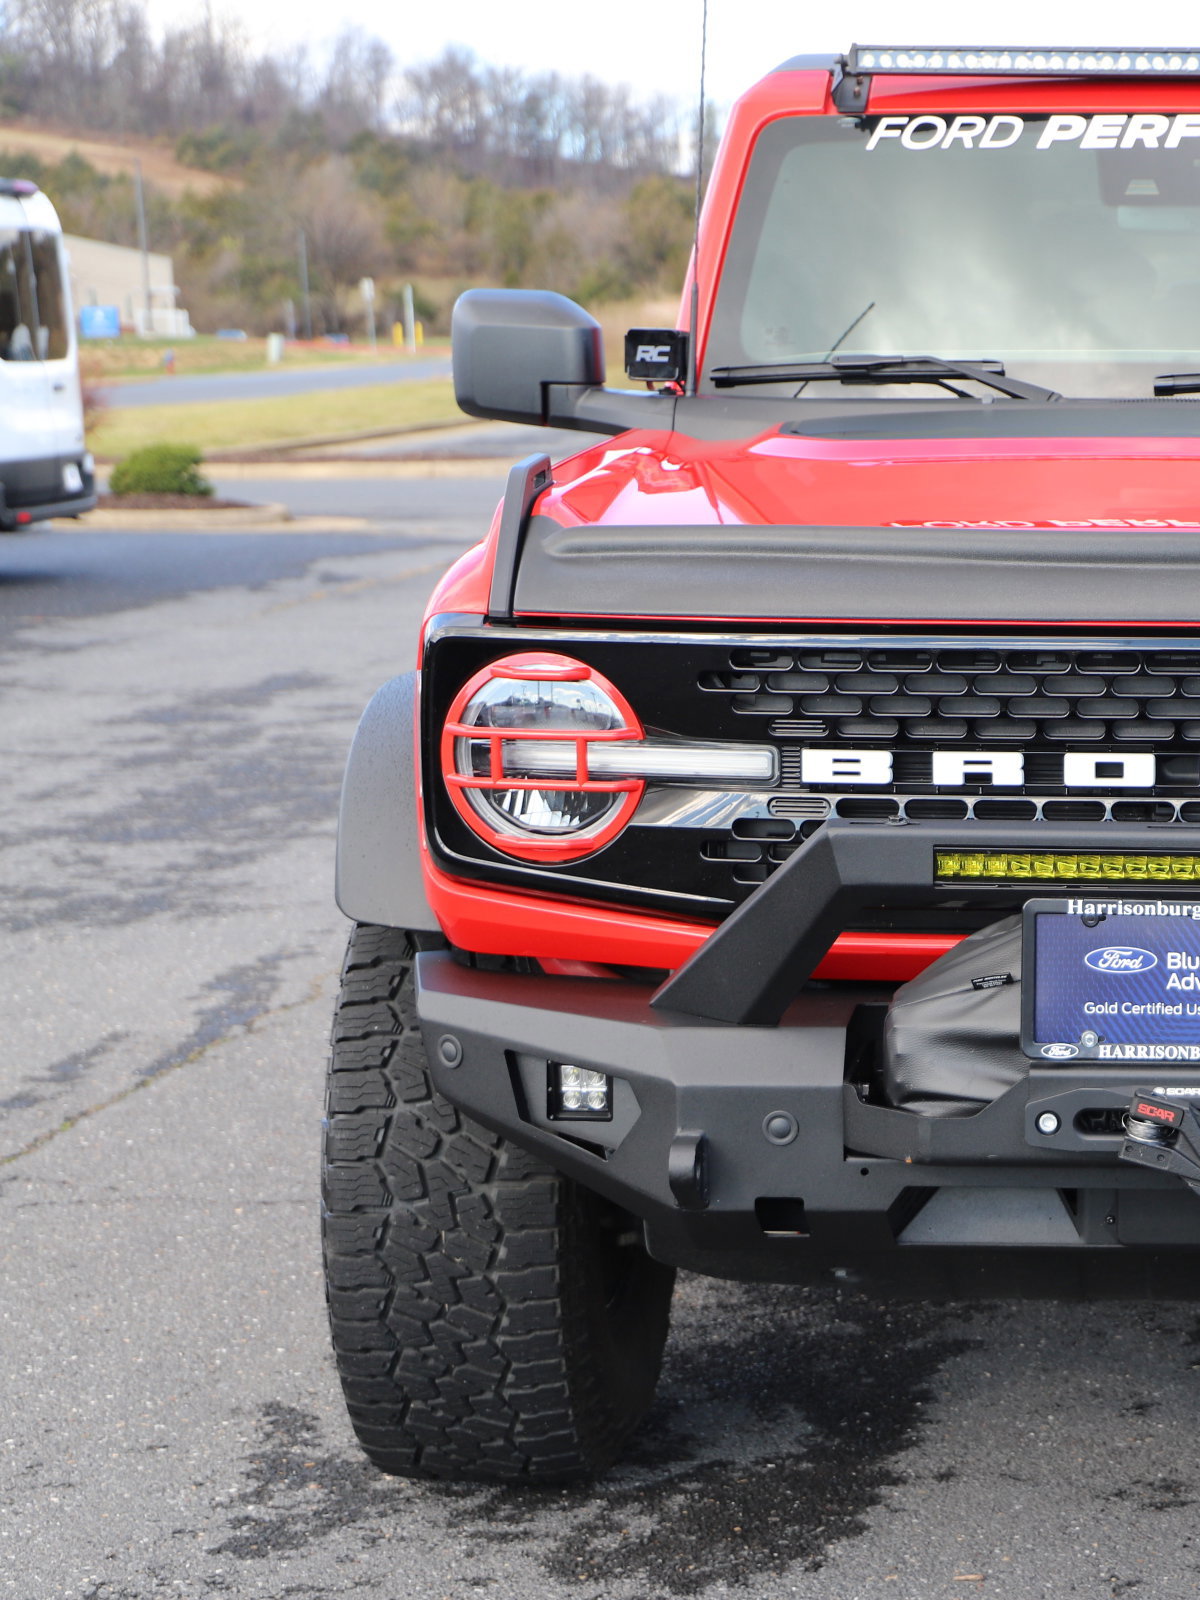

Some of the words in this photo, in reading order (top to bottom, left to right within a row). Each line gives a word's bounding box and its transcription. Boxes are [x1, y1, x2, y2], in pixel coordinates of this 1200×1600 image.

[866, 115, 1024, 150] FORD
[635, 345, 671, 362] RC
[1097, 948, 1144, 969] Ford
[1084, 1001, 1118, 1015] Gold
[1121, 1001, 1183, 1016] Certified
[1048, 1045, 1072, 1057] Ford
